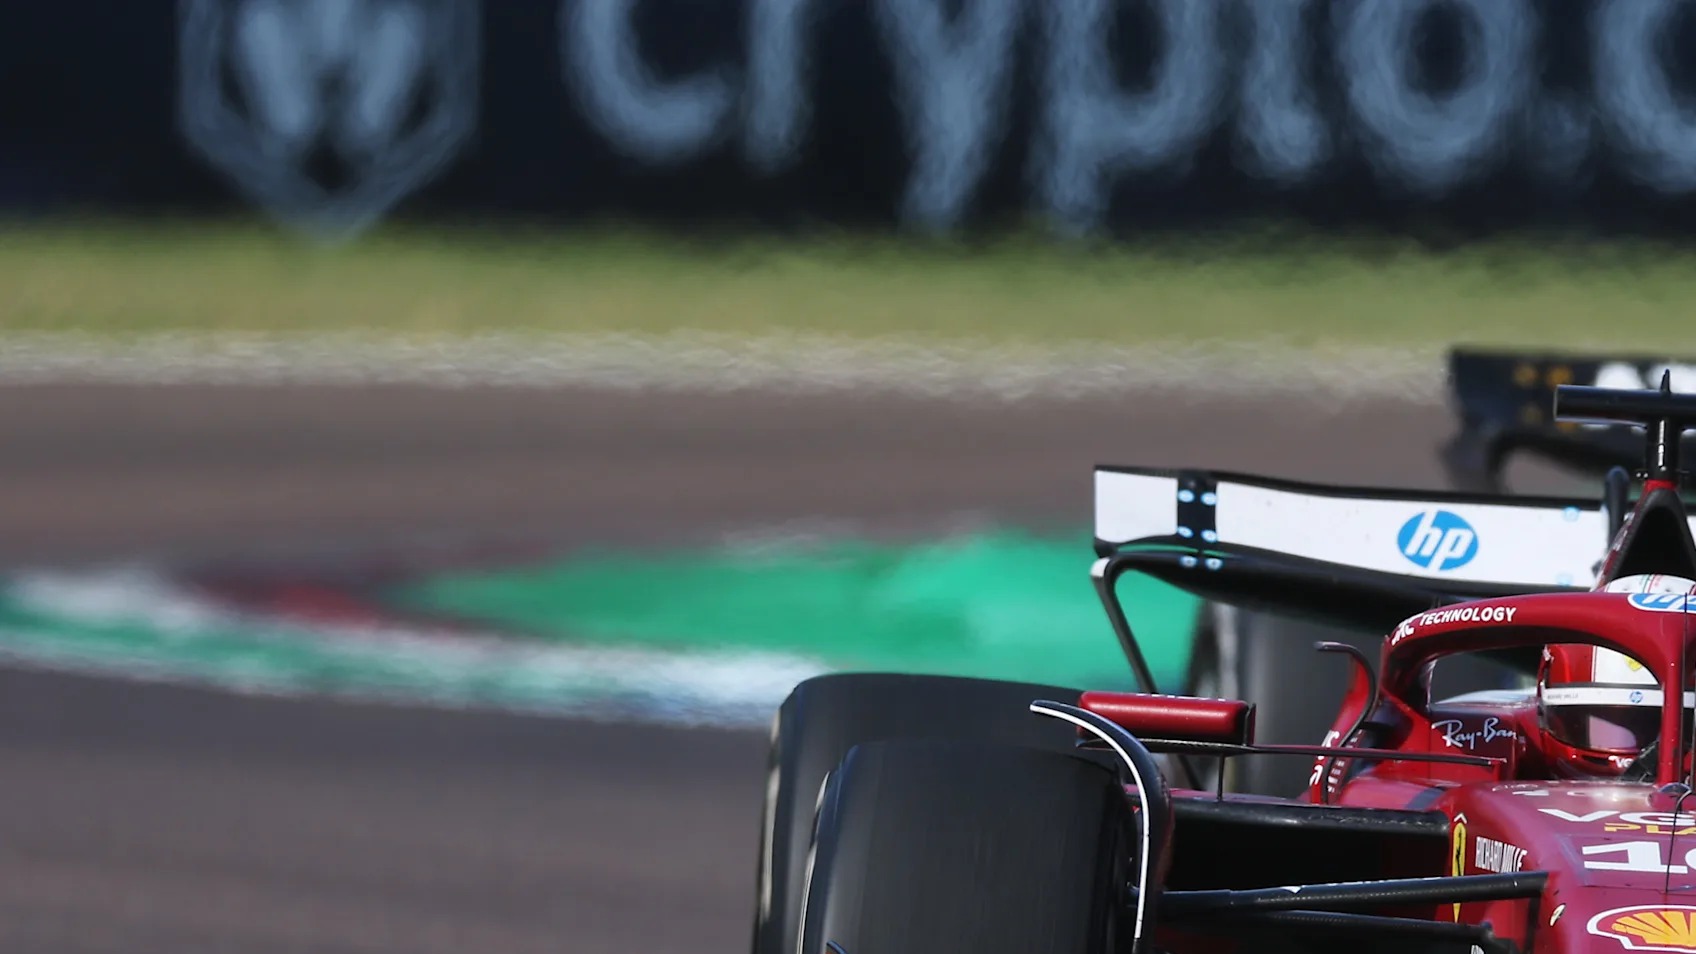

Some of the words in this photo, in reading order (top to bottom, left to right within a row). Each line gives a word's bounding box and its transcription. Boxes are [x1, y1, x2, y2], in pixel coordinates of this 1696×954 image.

[1402, 509, 1476, 572] hp
[1419, 606, 1517, 627] TECHNOLOGY
[1431, 717, 1517, 750] Ray-Ban
